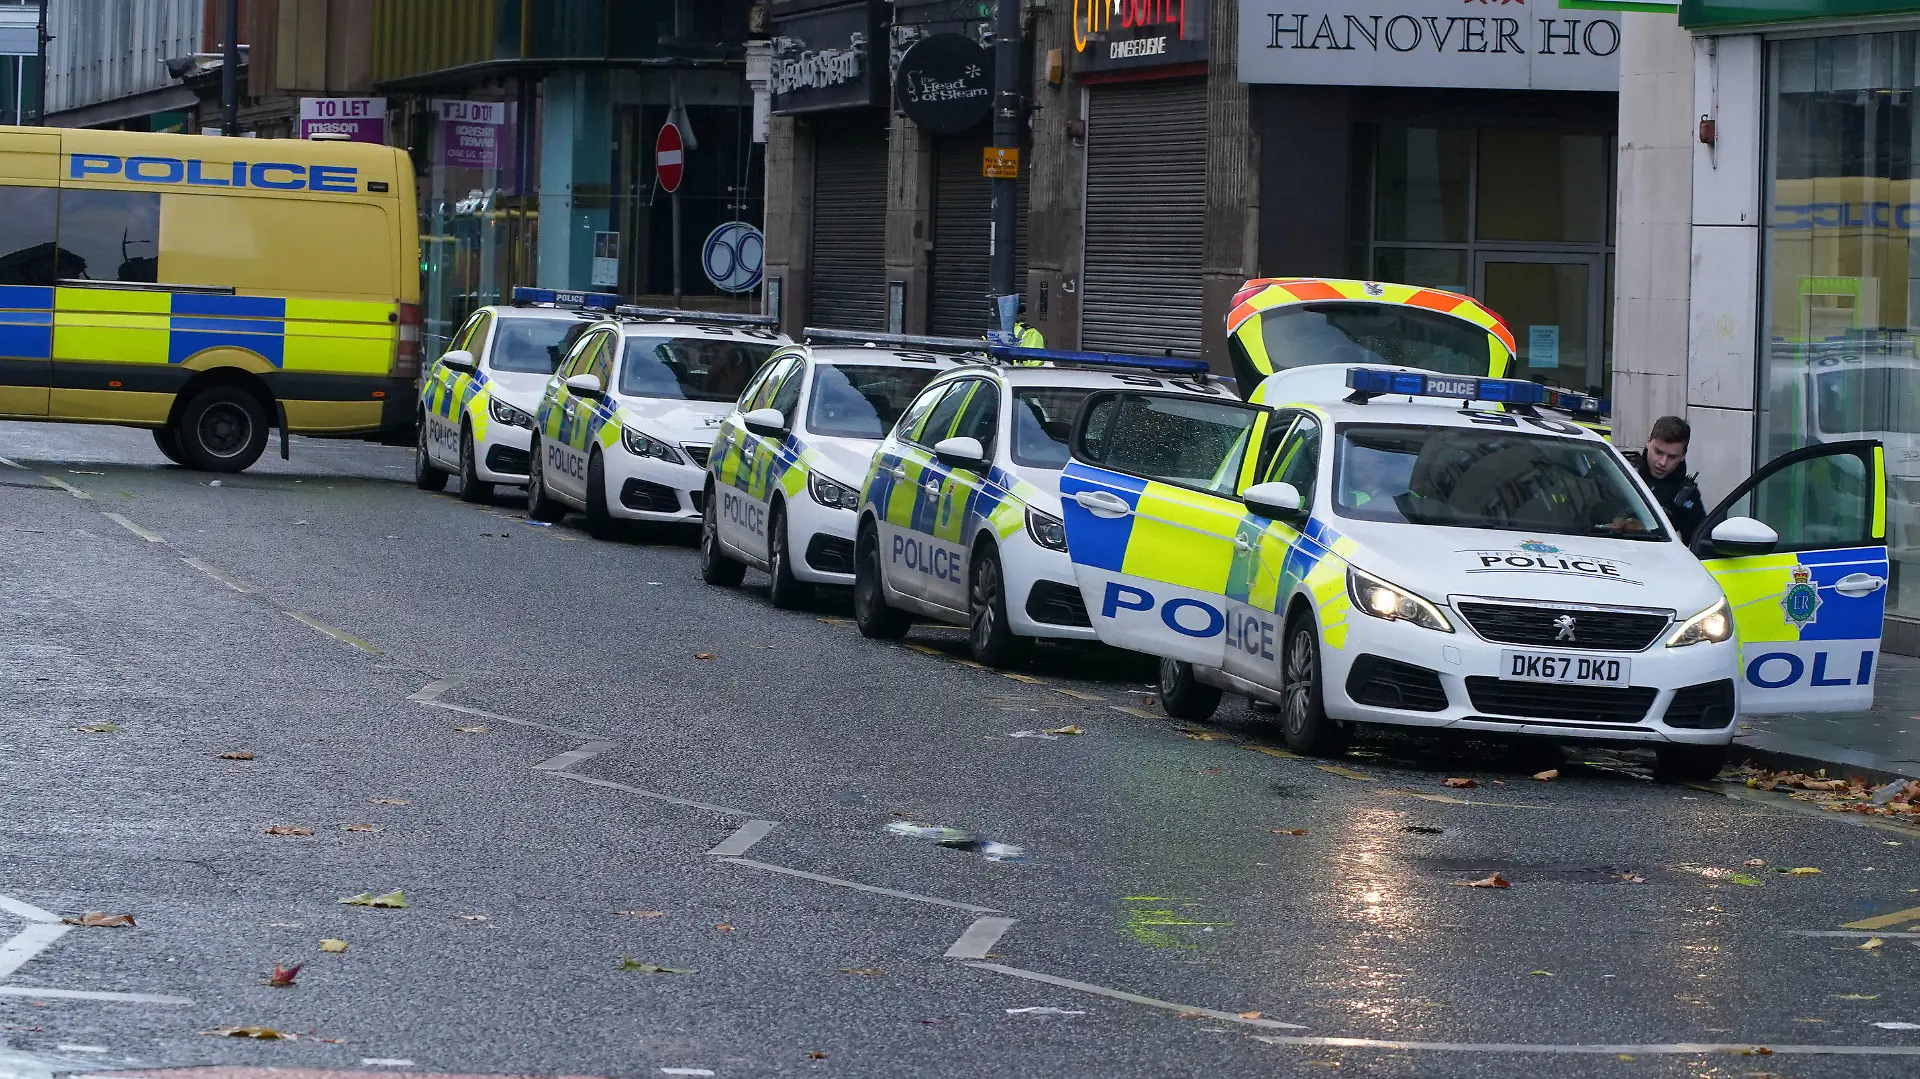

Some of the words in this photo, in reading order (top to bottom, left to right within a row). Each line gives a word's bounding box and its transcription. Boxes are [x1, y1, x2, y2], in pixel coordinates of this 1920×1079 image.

[1266, 13, 1525, 54] HANOVER
[1538, 18, 1621, 57] HO
[921, 90, 940, 102] of
[940, 87, 989, 101] Steam
[922, 79, 967, 94] Head
[315, 100, 337, 117] TO
[342, 100, 370, 117] LET
[307, 122, 359, 133] mason
[69, 152, 359, 194] POLICE
[556, 293, 585, 303] POLICE
[1427, 380, 1475, 395] POLICE
[429, 418, 459, 452] POLICE
[548, 444, 584, 481] POLICE
[723, 492, 765, 537] POLICE
[892, 533, 962, 585] POLICE
[1480, 556, 1620, 577] POLICE
[1511, 654, 1571, 679] DK67
[1577, 658, 1620, 682] DKD
[1746, 650, 1875, 689] OLI
